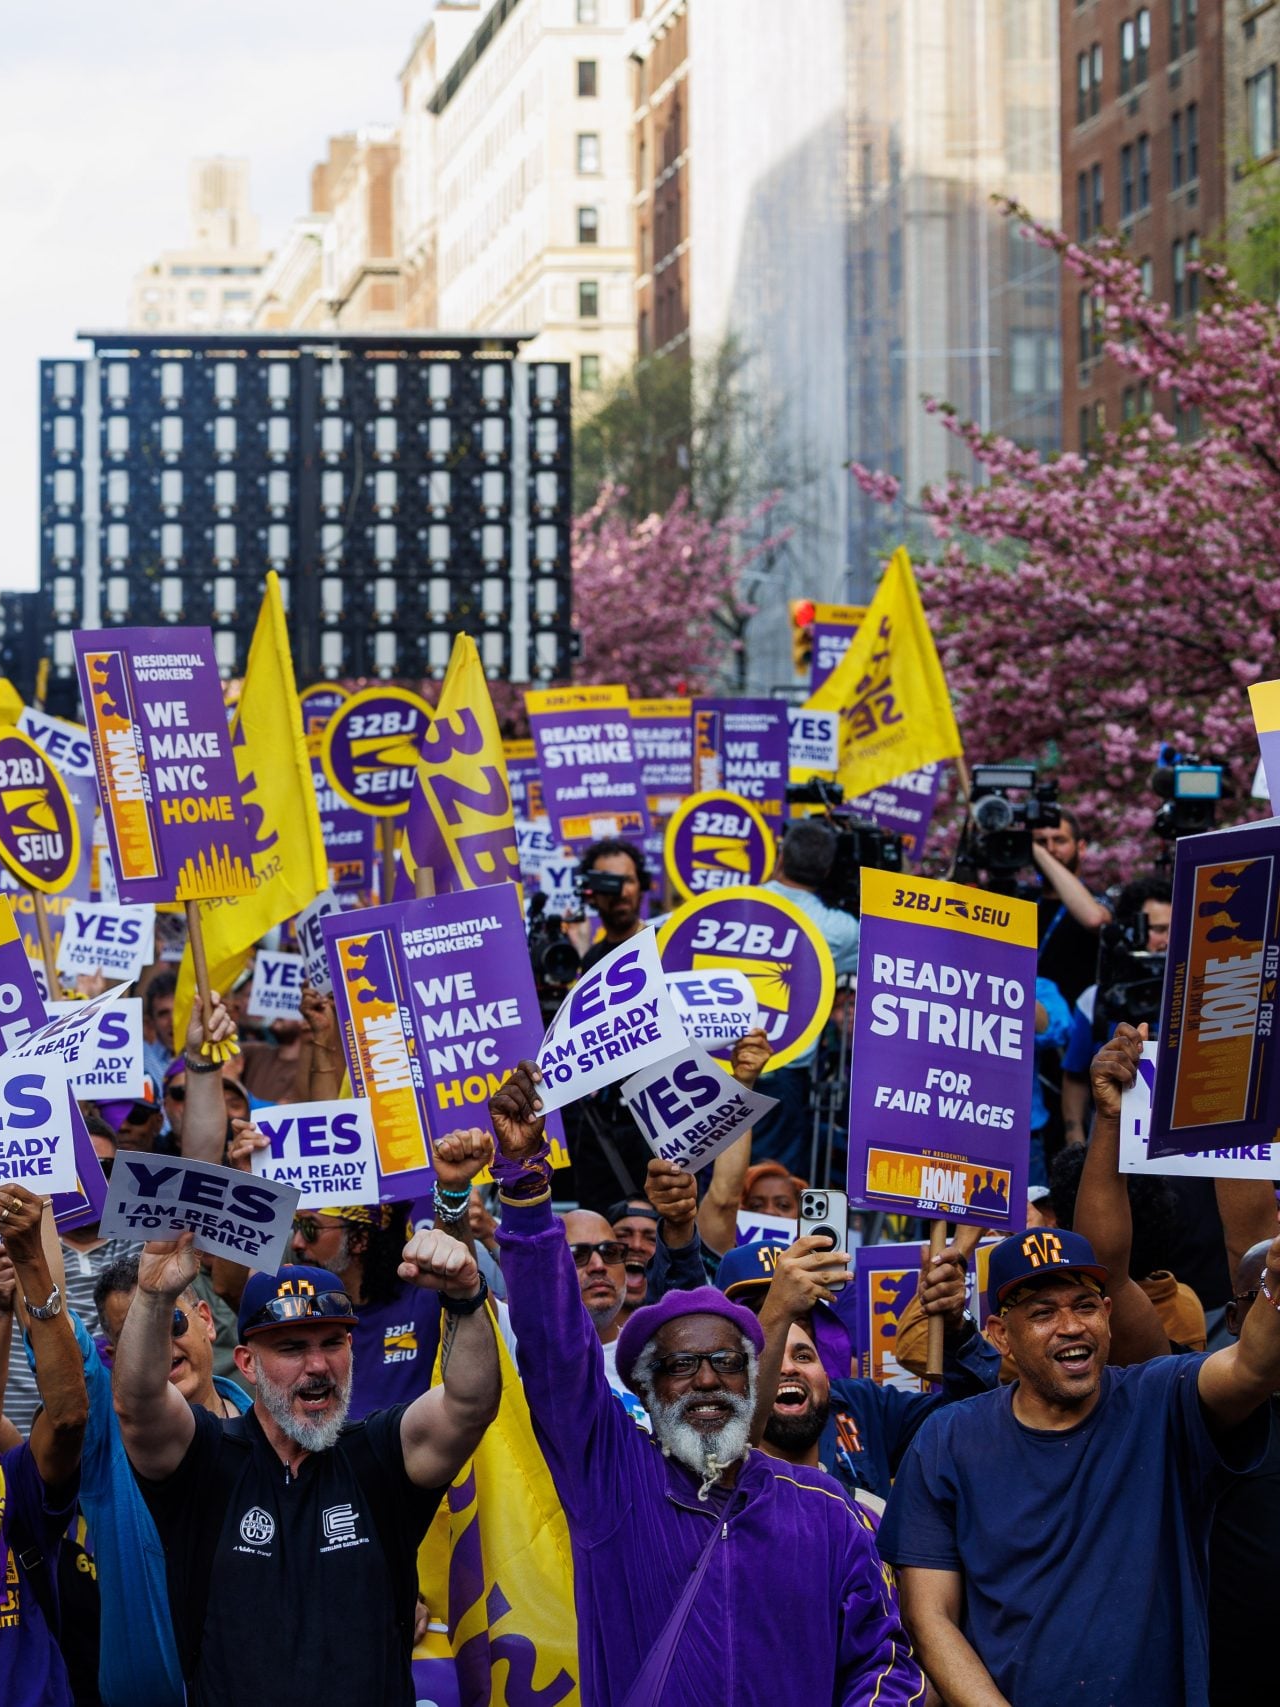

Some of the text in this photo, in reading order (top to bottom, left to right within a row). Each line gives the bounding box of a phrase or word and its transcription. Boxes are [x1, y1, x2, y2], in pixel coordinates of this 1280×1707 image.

[133, 653, 204, 668] RESIDENTIAL
[136, 668, 193, 682] WORKERS
[143, 701, 190, 727] WE
[347, 711, 418, 738] 32BJ
[149, 732, 220, 760] MAKE
[540, 724, 628, 746] READY TO
[726, 743, 758, 759] WE
[106, 728, 143, 801] HOME
[133, 724, 153, 803] 32BJ SEIU
[545, 744, 633, 768] STRIKE
[726, 761, 781, 778] MAKE
[155, 765, 207, 792] NYC
[354, 767, 416, 795] SEIU
[556, 783, 636, 801] FAIR WAGES
[581, 772, 609, 786] FOR
[726, 780, 764, 798] NYC
[161, 796, 234, 825] HOME
[691, 812, 751, 837] 32BJ
[18, 833, 65, 862] SEIU
[892, 889, 1010, 928] 32BJ SEIU
[74, 912, 140, 945] YES
[401, 916, 502, 946] RESIDENTIAL
[691, 919, 798, 957] 32BJ
[70, 954, 129, 969] TO STRIKE
[74, 944, 137, 959] AM READY
[403, 934, 483, 959] WORKERS
[414, 972, 476, 1006] WE
[873, 954, 1024, 1010] READY TO
[1199, 952, 1262, 1042] HOME
[1257, 945, 1280, 1036] 32BJ SEIU
[421, 999, 521, 1041] MAKE
[1168, 961, 1186, 1049] NY RESIDENTIAL
[581, 998, 659, 1056] READY
[870, 993, 1023, 1060] STRIKE
[344, 1020, 361, 1081] RESIDENTIAL
[363, 1012, 411, 1092] HOME
[400, 1006, 425, 1089] 32BJ SEIU
[429, 1042, 499, 1076] NYC
[581, 1021, 661, 1074] STRIKE
[925, 1068, 971, 1096] FOR
[629, 1059, 720, 1141] YES
[874, 1086, 1014, 1130] FAIR WAGES
[259, 1113, 361, 1160] YES
[686, 1093, 745, 1154] READY
[932, 1150, 968, 1162] RESIDENTIAL
[125, 1162, 276, 1223] YES
[921, 1166, 967, 1205] HOME
[917, 1200, 966, 1215] 32BJ SEIU
[126, 1215, 260, 1256] TO STRIKE
[132, 1203, 275, 1246] AM READY
[383, 1349, 417, 1364] SEIU
